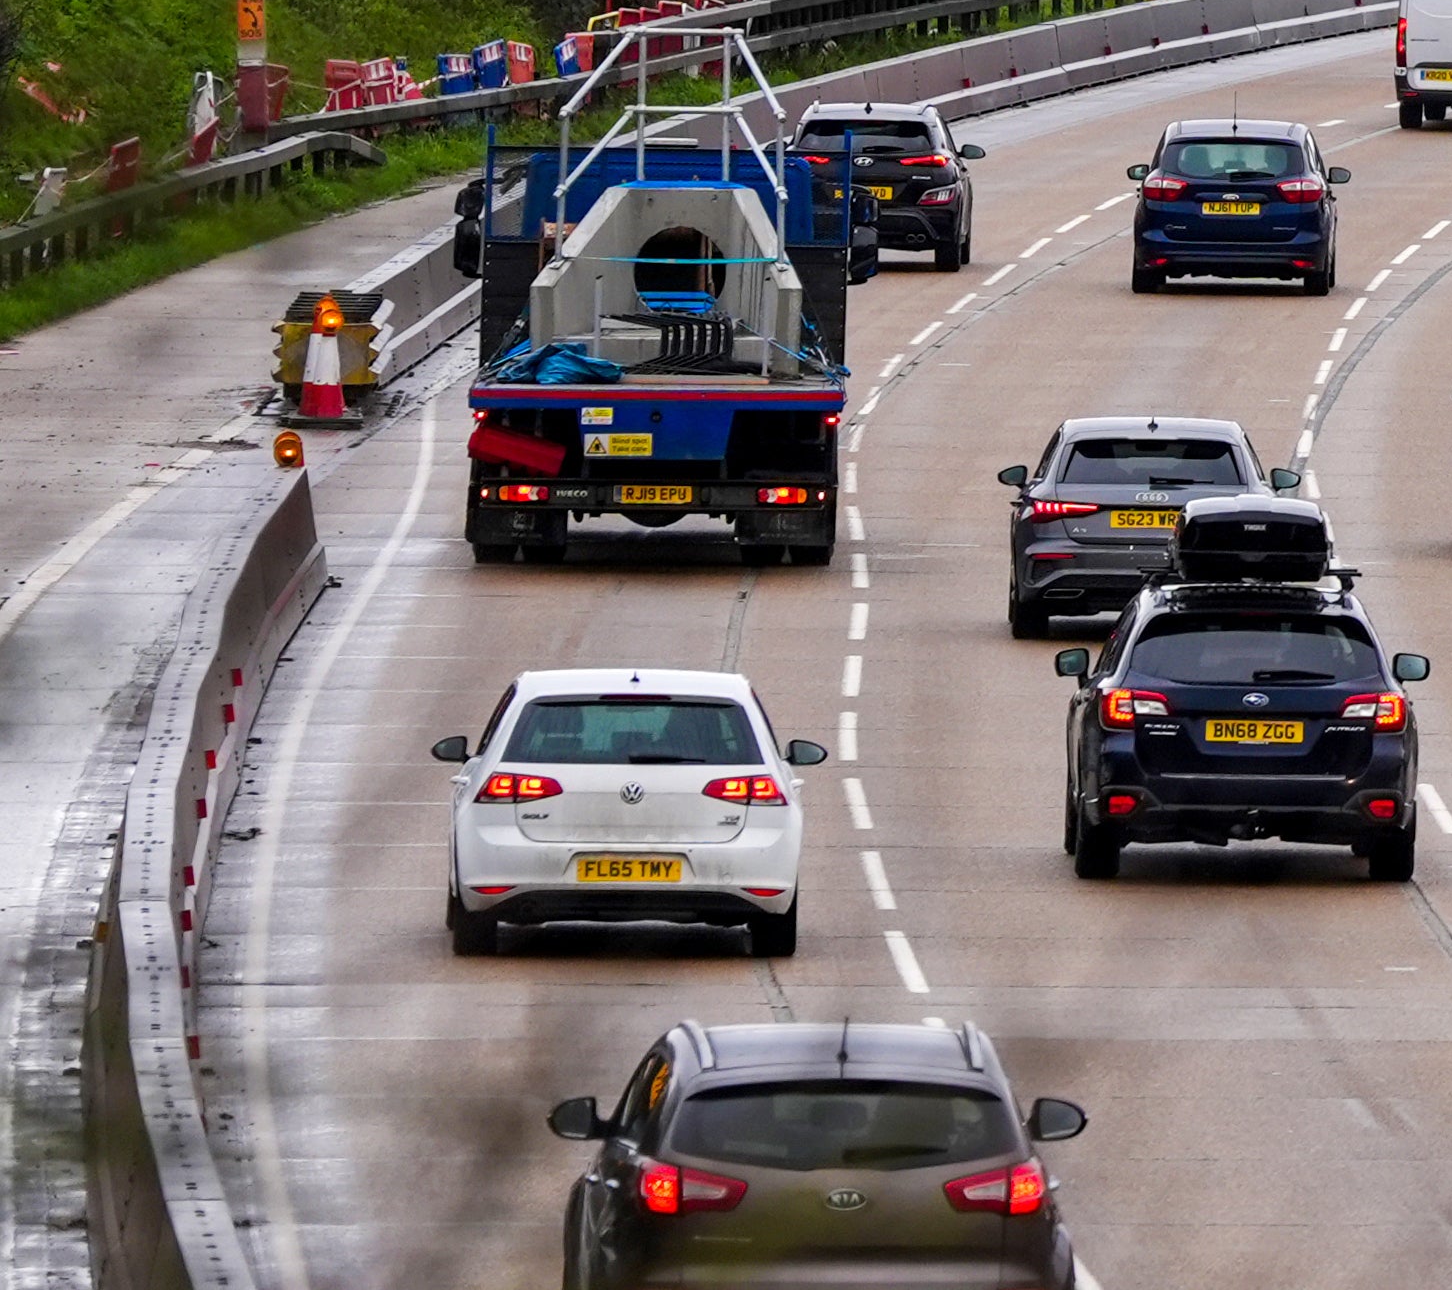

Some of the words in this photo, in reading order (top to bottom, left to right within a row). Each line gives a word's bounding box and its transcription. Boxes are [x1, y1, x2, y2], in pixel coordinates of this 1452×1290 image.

[240, 29, 262, 38] SOS
[1208, 203, 1231, 213] NJ61
[1235, 203, 1255, 213] TUP
[555, 488, 589, 498] IVECO
[625, 485, 656, 500] RJ19
[1117, 513, 1154, 526] SG23
[1158, 513, 1176, 526] WR
[1213, 722, 1258, 738] BN68
[1262, 723, 1295, 740] ZGG
[584, 860, 633, 878] FL65
[638, 861, 673, 879] TMY
